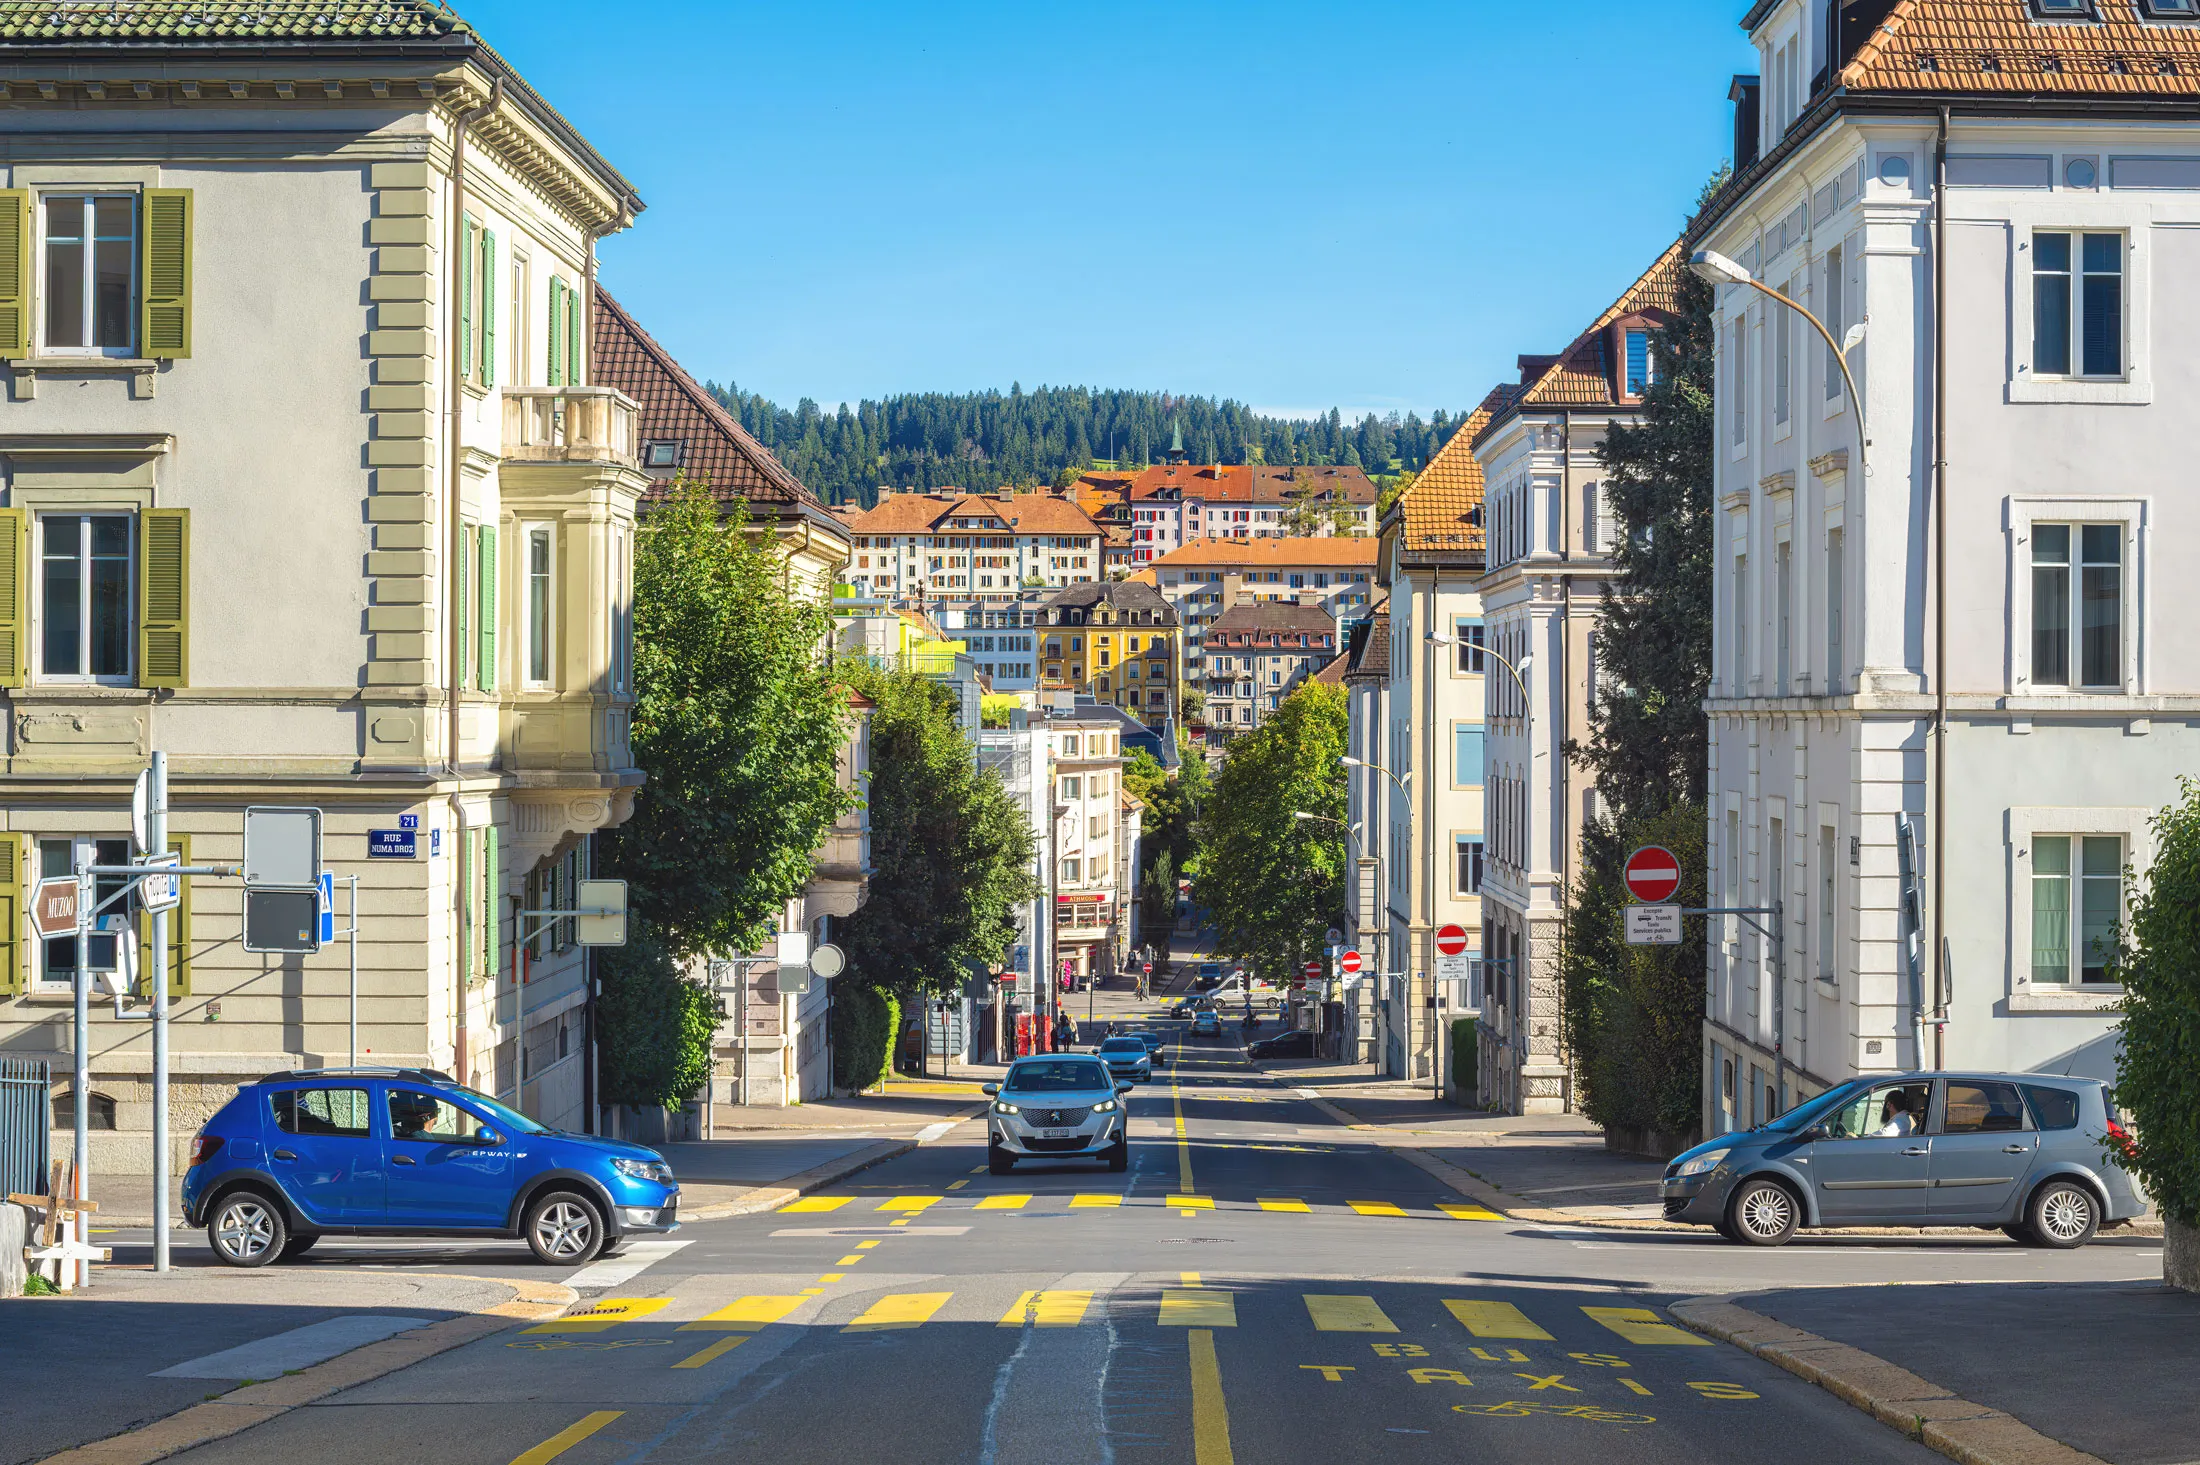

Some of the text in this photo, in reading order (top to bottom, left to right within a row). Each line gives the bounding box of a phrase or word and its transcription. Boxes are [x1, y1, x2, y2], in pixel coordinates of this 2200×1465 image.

[404, 816, 415, 827] 71
[383, 834, 402, 842] RUE
[371, 844, 414, 853] NUMA DROZ
[47, 896, 74, 919] MUZOO
[1370, 1343, 1631, 1367] BUS
[1299, 1365, 1760, 1399] TAXIS
